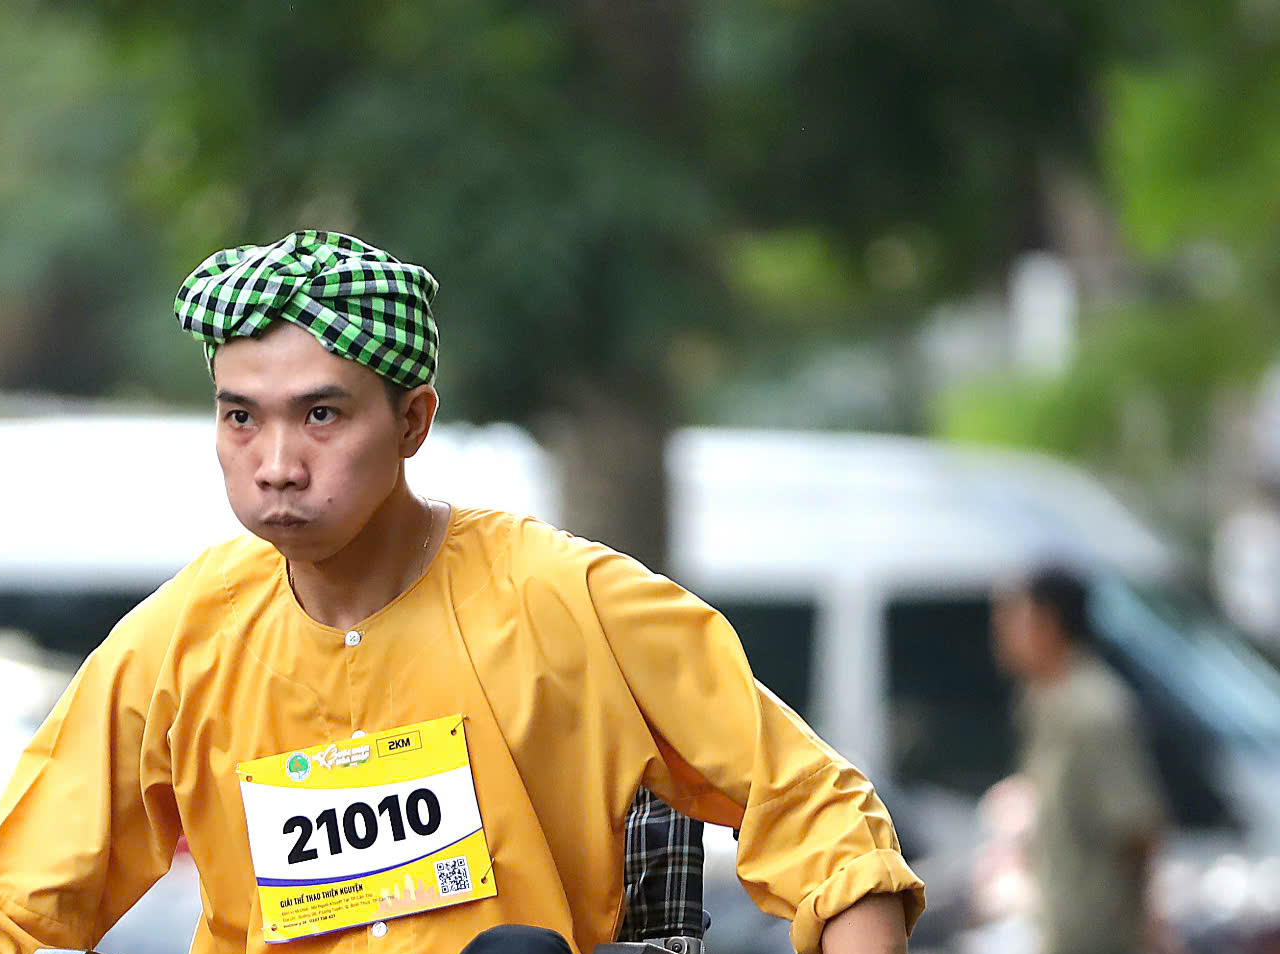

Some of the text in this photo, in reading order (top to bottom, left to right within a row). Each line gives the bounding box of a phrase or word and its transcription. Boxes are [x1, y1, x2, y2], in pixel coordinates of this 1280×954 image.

[388, 737, 411, 751] 2KM
[282, 788, 442, 865] 21010
[306, 893, 321, 903] THAO
